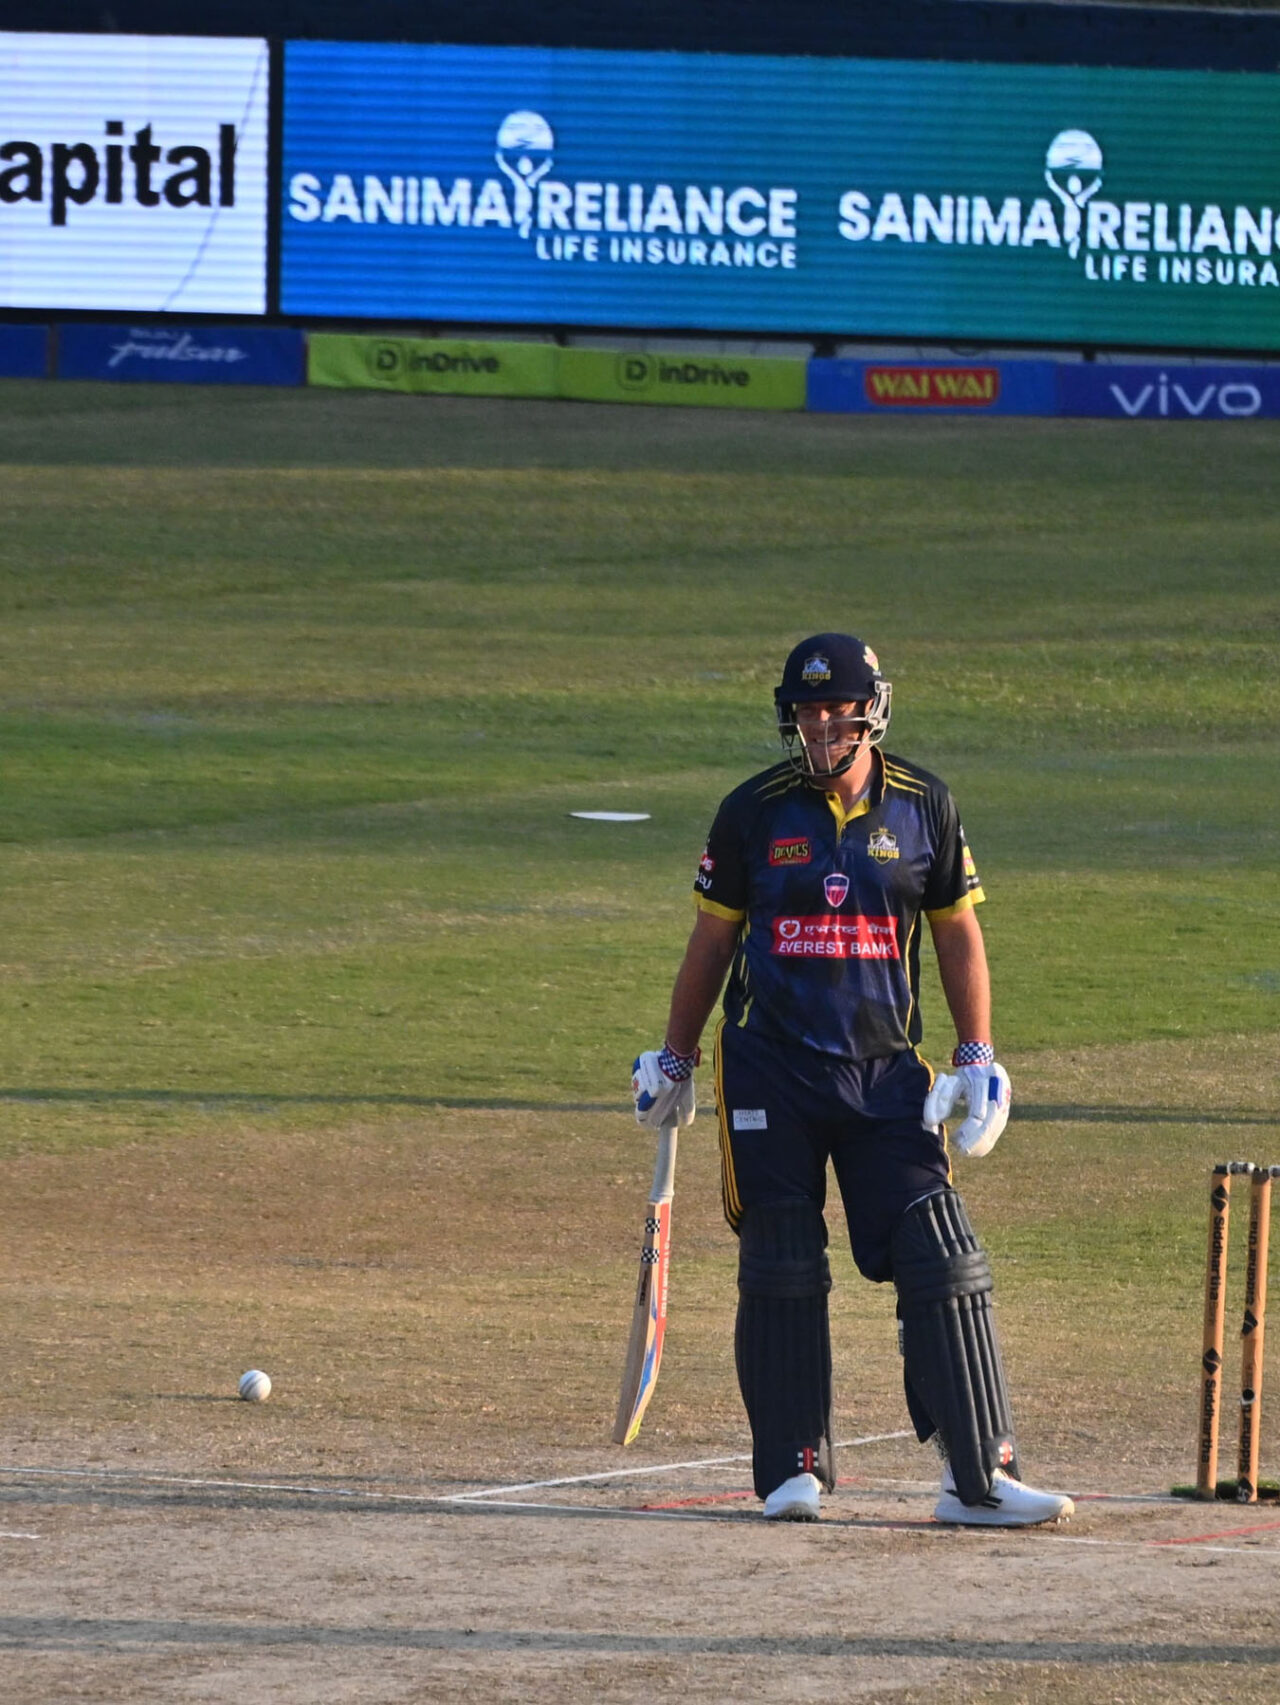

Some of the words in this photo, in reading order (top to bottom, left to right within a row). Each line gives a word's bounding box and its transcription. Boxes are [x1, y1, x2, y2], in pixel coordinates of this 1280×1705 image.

[288, 173, 519, 230] SANIMA
[546, 181, 798, 239] RELIANCE
[838, 190, 1060, 249] SANIMA
[536, 235, 600, 263] LIFE
[609, 237, 798, 270] INSURANCE
[1084, 255, 1148, 284] LIFE
[659, 361, 750, 387] inDrive
[870, 373, 929, 399] WAI
[934, 373, 994, 401] WAI
[1109, 372, 1263, 416] vivo
[778, 940, 846, 955] EVEREST
[850, 941, 894, 956] BANK
[1209, 1215, 1225, 1301] Siddhartha
[1202, 1378, 1217, 1464] Siddhartha
[1240, 1403, 1252, 1474] Siddhart
